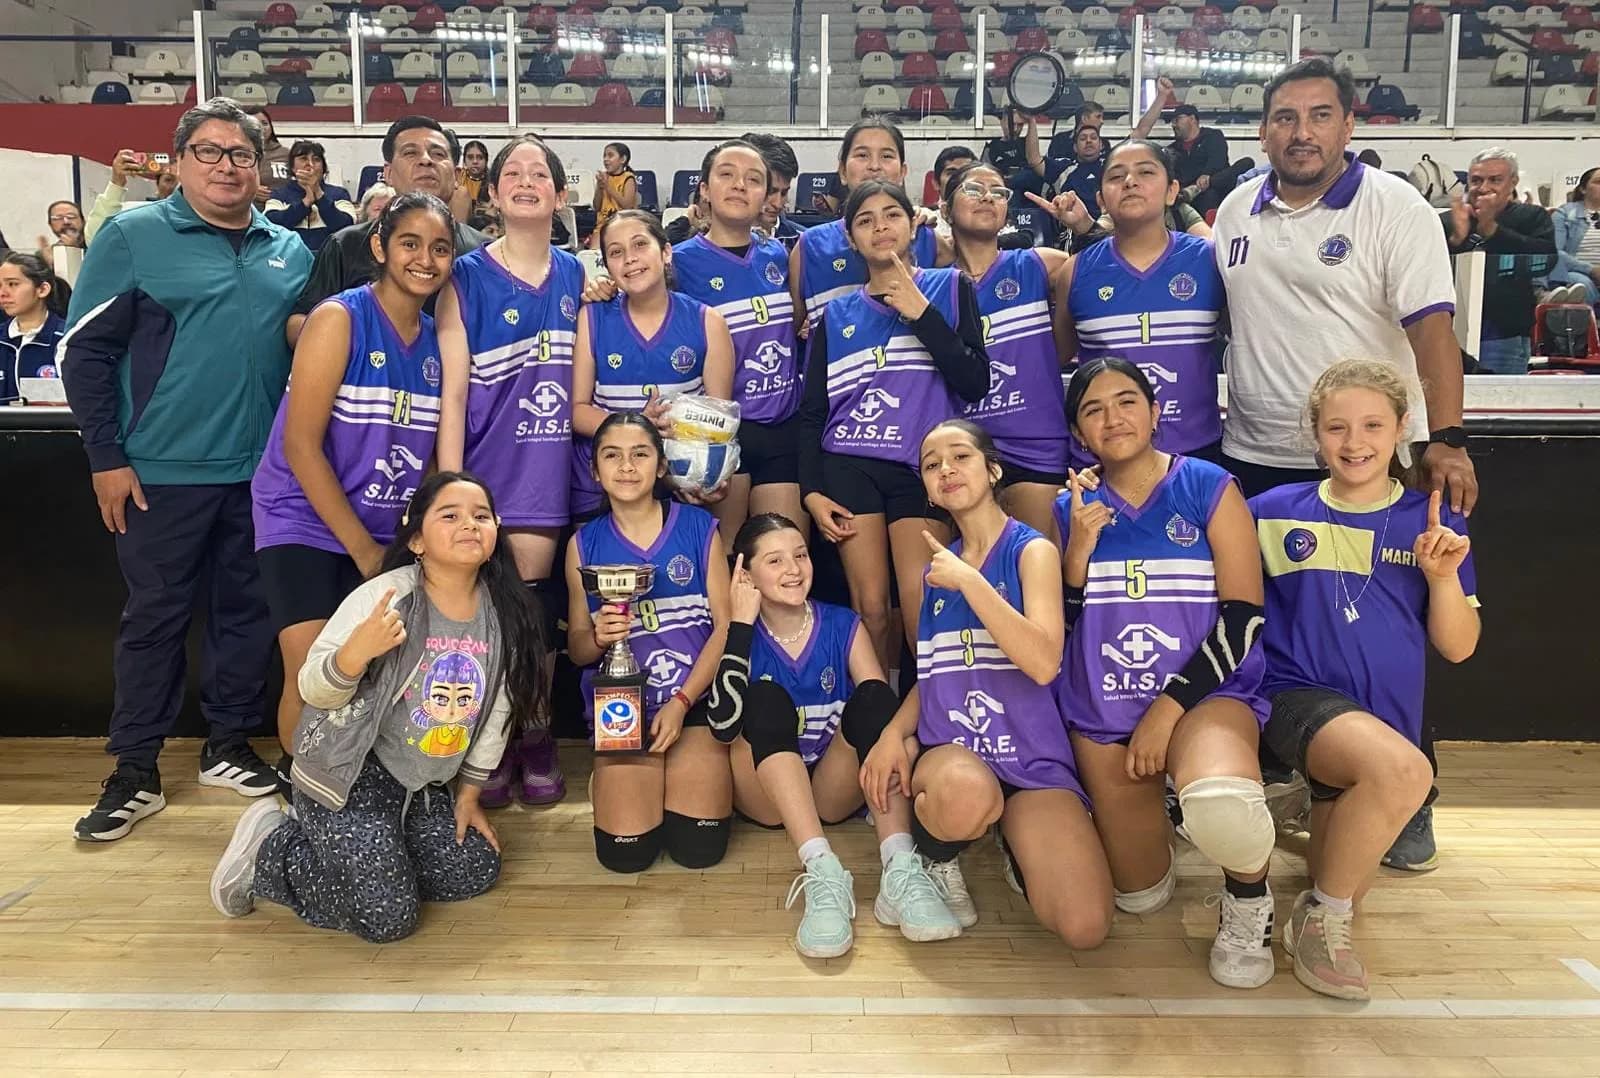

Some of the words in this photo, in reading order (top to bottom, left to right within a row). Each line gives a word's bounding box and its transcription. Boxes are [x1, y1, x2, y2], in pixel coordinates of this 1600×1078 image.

[1566, 176, 1580, 186] 217
[1016, 214, 1032, 225] 182
[751, 296, 770, 326] 9
[1137, 311, 1150, 344] 1
[538, 329, 552, 362] 6
[392, 389, 412, 426] 11
[834, 424, 903, 440] S.I.S.E.
[1124, 559, 1148, 600] 5
[638, 599, 660, 632] 8
[1344, 602, 1360, 623] M
[960, 628, 976, 668] 3
